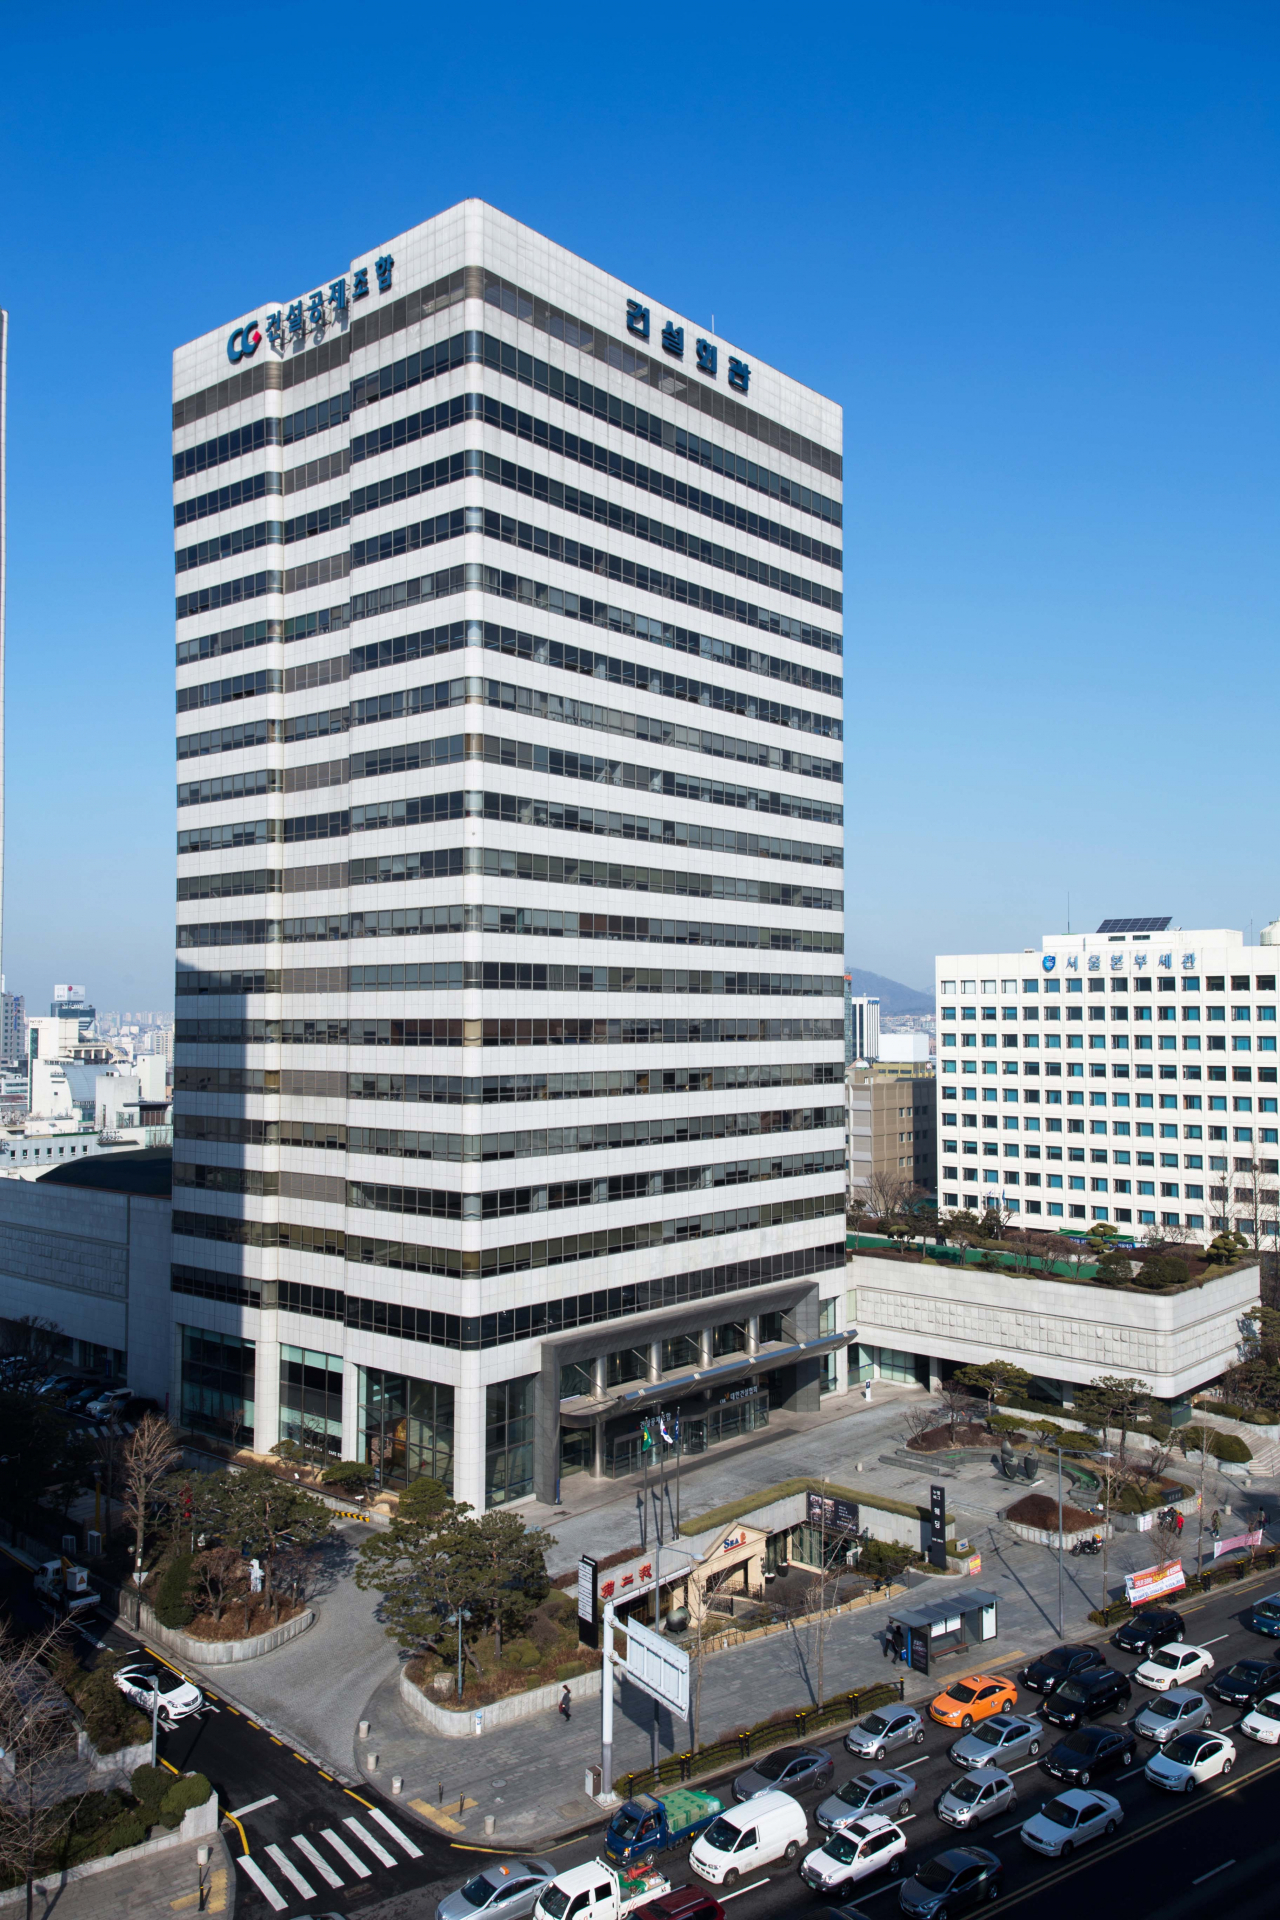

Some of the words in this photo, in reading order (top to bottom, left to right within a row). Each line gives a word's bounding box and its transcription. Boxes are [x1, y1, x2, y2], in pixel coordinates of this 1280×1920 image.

[265, 253, 395, 343] 건설공제조합
[626, 298, 752, 392] 건설회관
[1065, 952, 1197, 972] 서울본부세관
[730, 1385, 758, 1401] 대한건설협회
[724, 1538, 739, 1549] SEA
